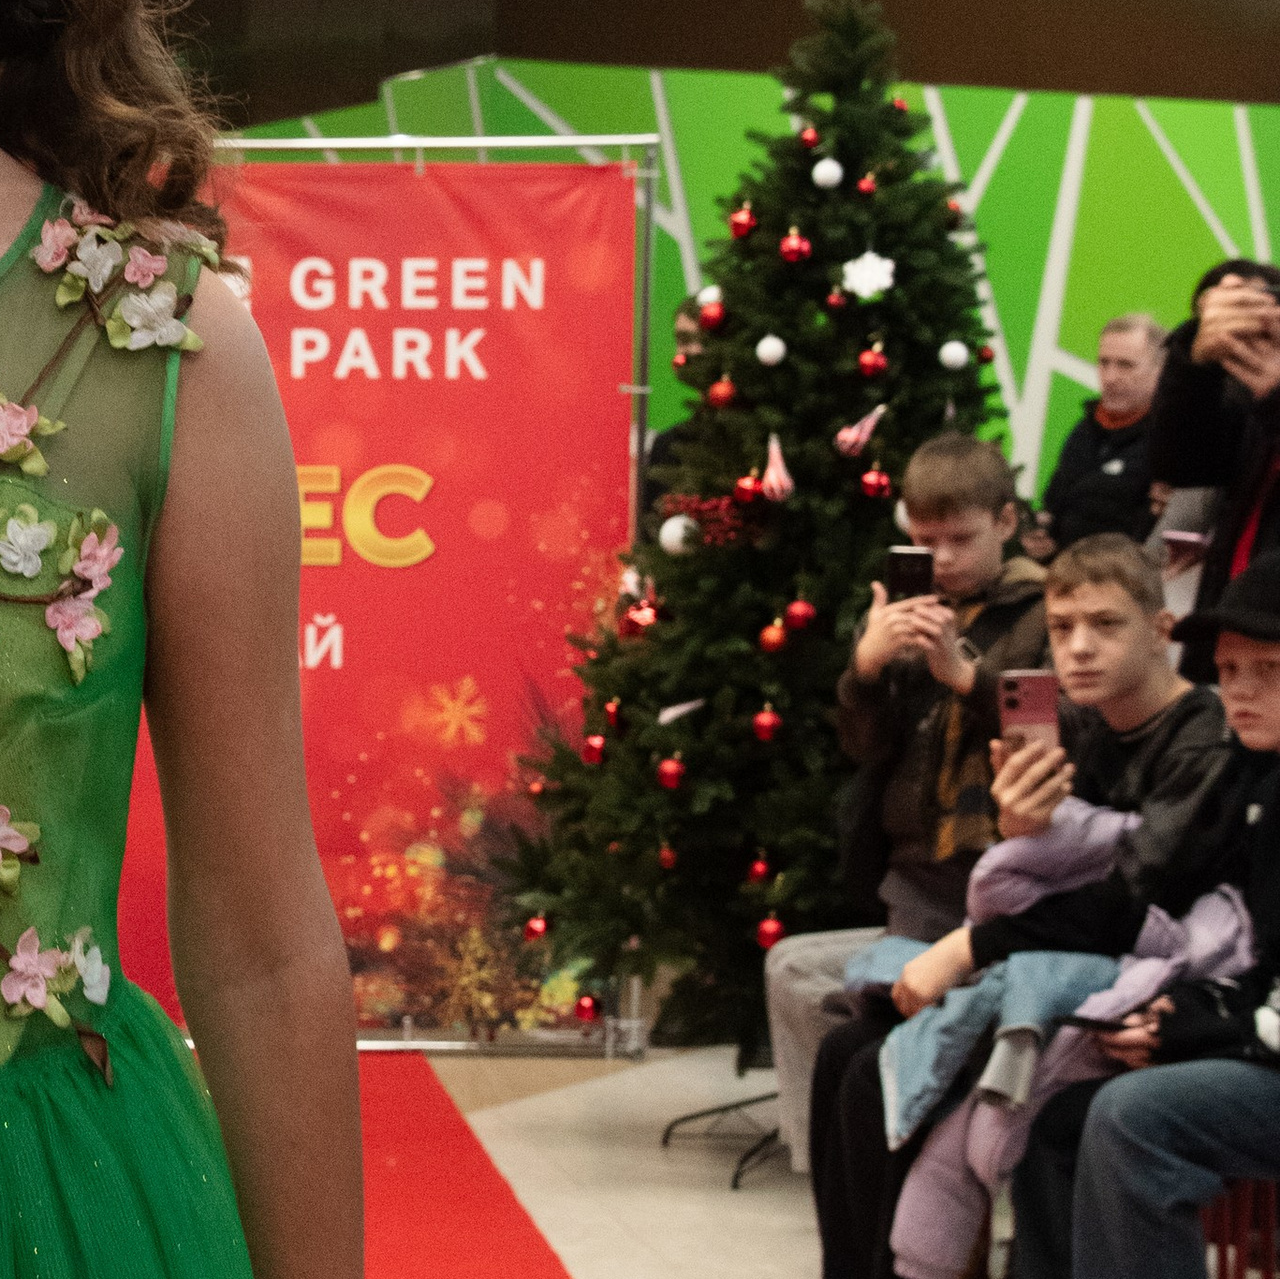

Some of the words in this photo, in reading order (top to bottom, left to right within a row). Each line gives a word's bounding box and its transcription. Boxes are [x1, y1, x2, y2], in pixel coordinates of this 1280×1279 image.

[289, 256, 545, 311] GREEN
[290, 327, 489, 381] PARK
[297, 463, 435, 569] ЕС
